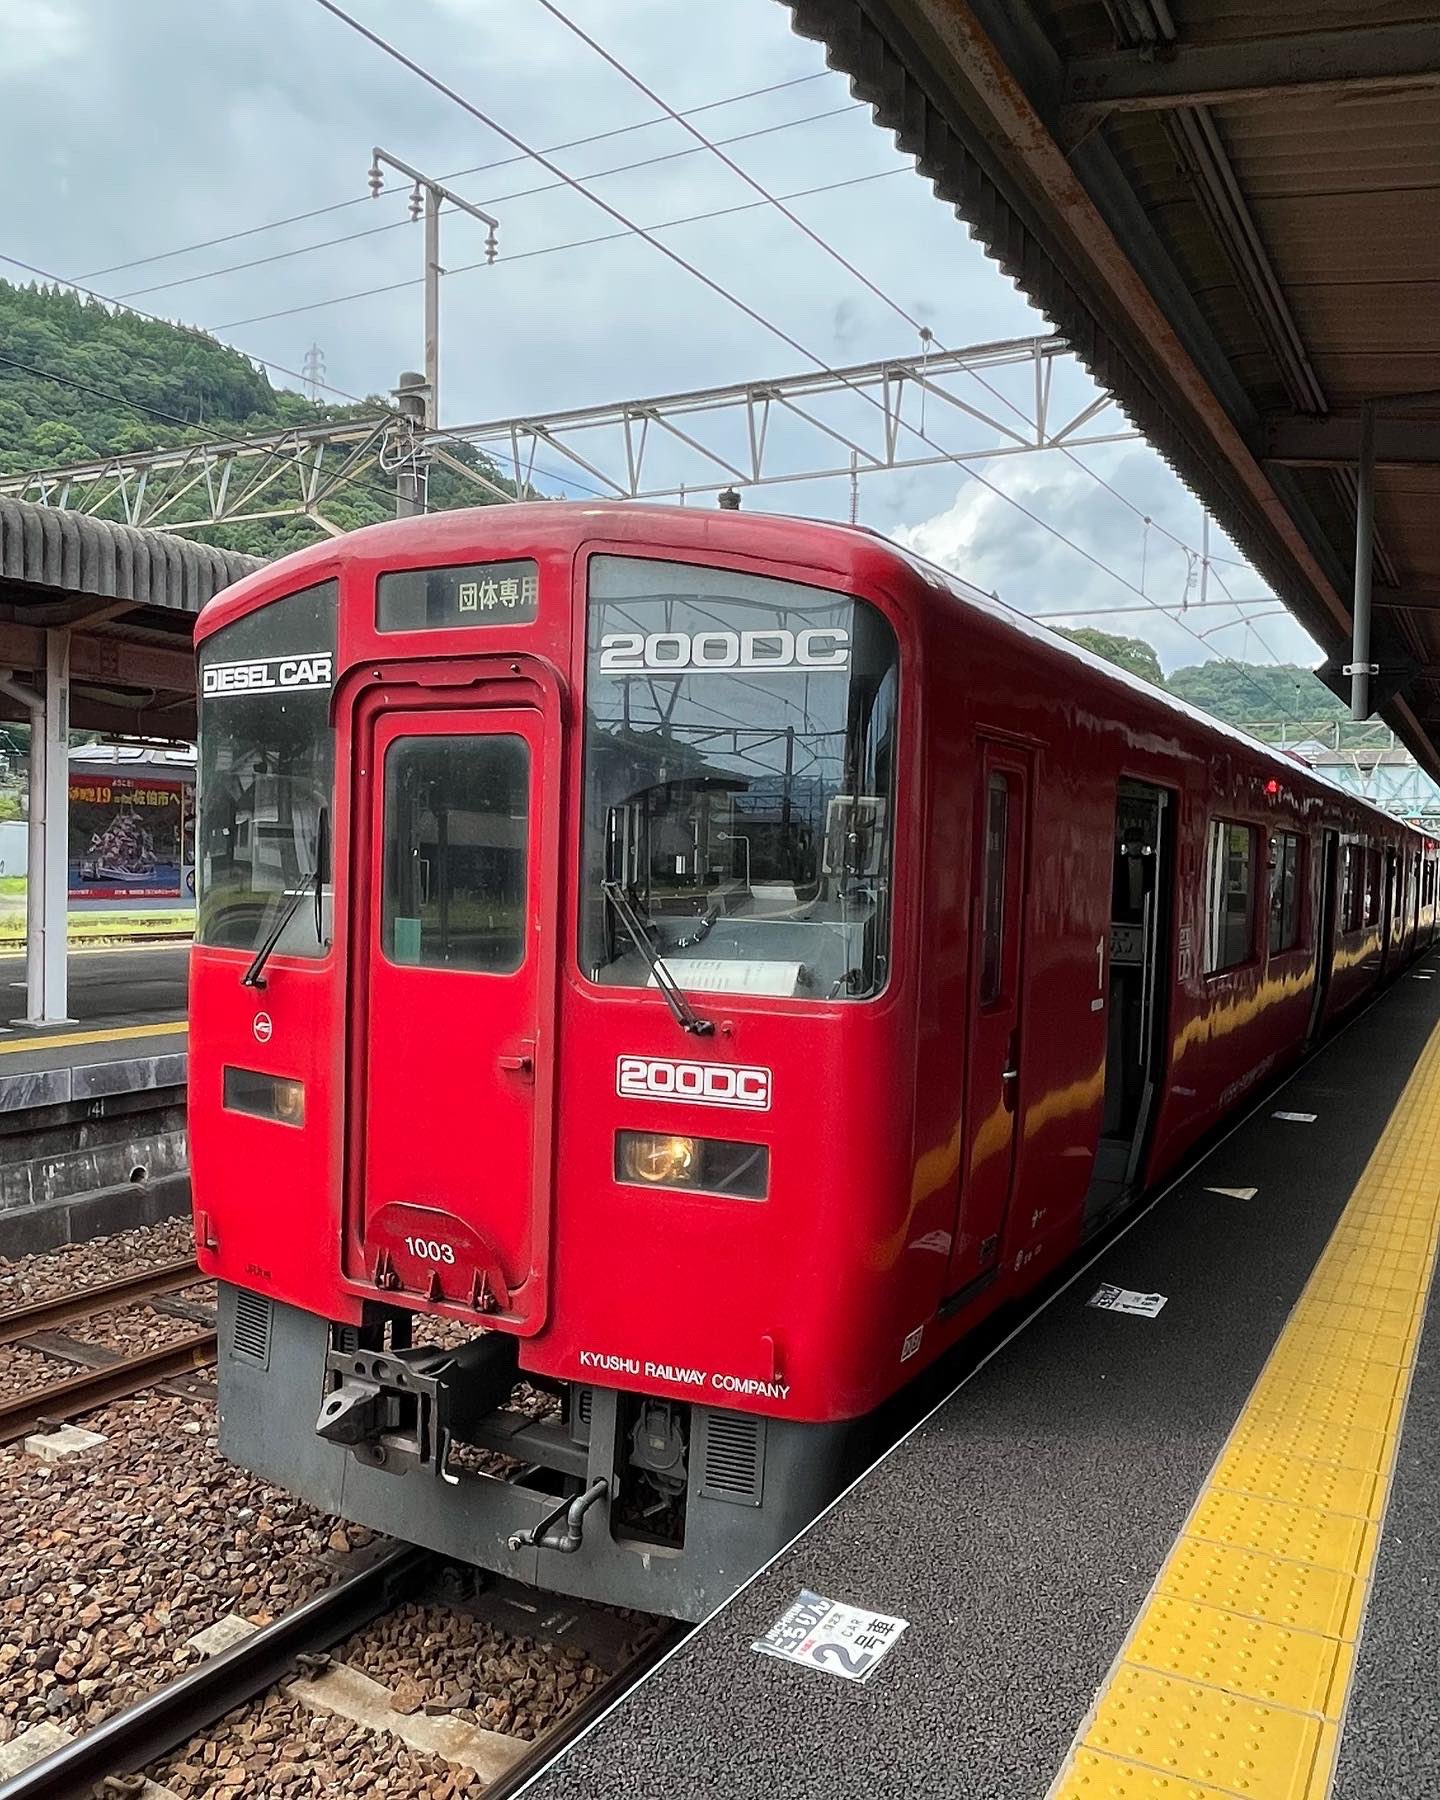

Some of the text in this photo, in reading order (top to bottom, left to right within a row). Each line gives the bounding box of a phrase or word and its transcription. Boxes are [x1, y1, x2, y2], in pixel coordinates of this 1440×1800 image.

[459, 576, 537, 612] 団体専用
[600, 629, 849, 668] 200DC
[203, 659, 332, 693] DIESEL CAR
[621, 1059, 768, 1101] 200DC
[404, 1236, 455, 1265] 1003
[579, 1350, 790, 1400] KYUSHU RAILWAY COMPANY
[841, 1618, 865, 1638] CAR
